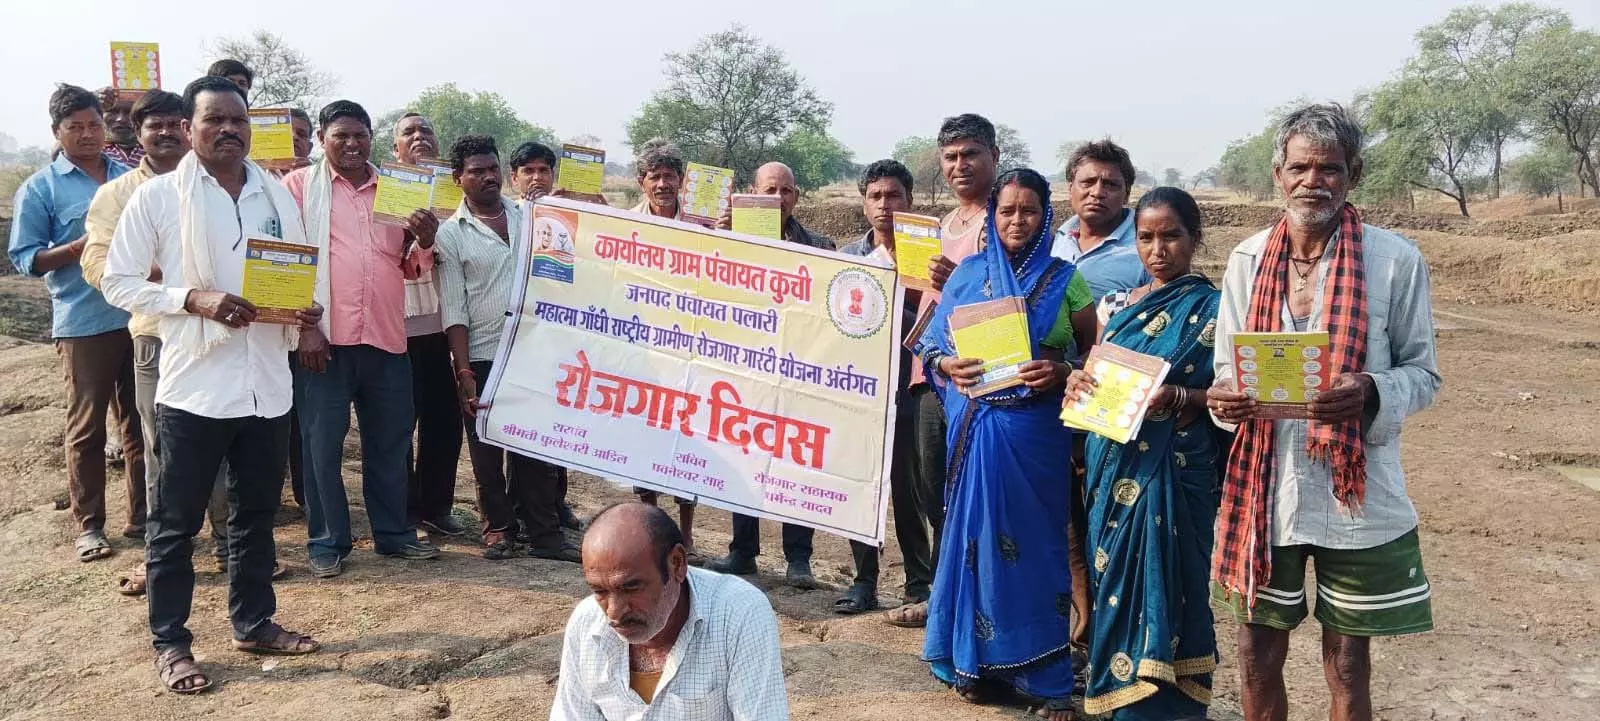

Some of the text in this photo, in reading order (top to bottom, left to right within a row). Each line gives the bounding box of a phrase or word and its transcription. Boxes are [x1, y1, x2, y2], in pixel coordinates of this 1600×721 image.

[594, 231, 666, 270] कार्यालय
[668, 248, 703, 279] ग्राम
[705, 251, 767, 292] पंचायत
[770, 265, 813, 304] कुची
[625, 283, 779, 334] जनपद पंचायत पलारी
[535, 301, 879, 397] महात्मा गाँधी राष्ट्रीय ग्रामीण रोजगार गारंटी योजना अंर्तगत
[555, 349, 831, 470] रोजगार दिवस
[503, 423, 538, 441] श्रीमती
[592, 448, 628, 464] आडिल
[800, 484, 848, 502] सहायक
[800, 499, 833, 516] यादव
